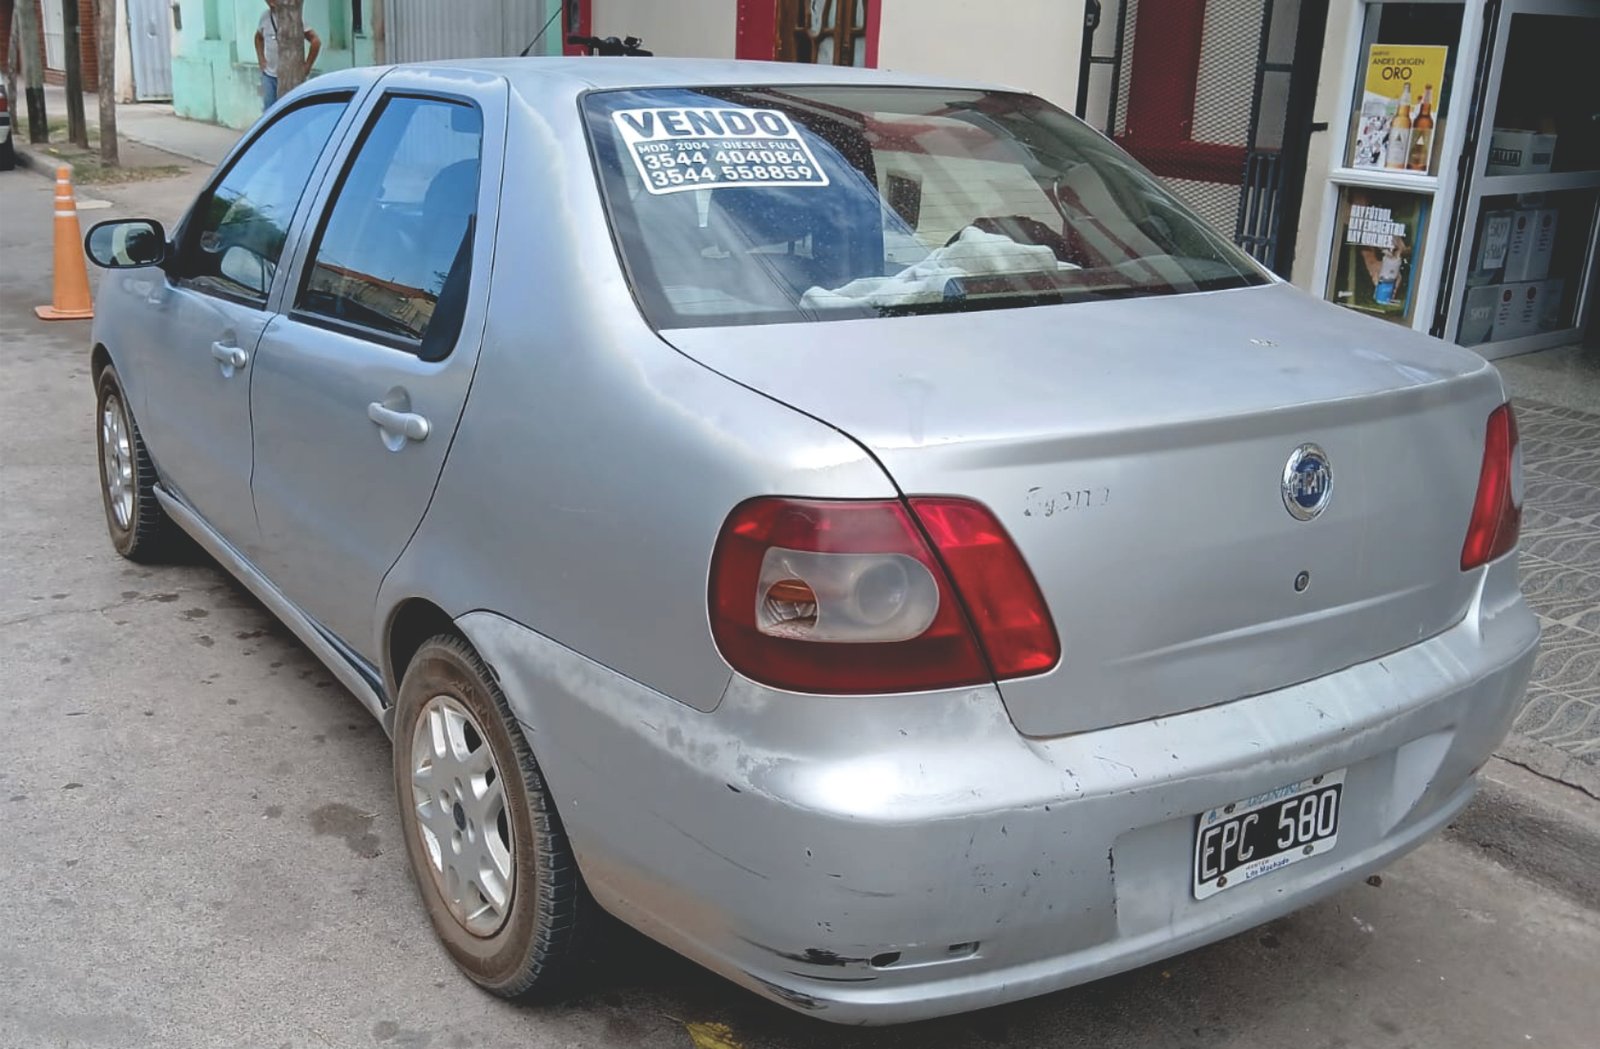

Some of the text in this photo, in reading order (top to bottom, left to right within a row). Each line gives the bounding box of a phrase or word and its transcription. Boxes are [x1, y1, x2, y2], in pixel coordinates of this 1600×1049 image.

[1372, 57, 1425, 66] ANDES ORIGEN
[1381, 66, 1413, 81] ORO
[620, 110, 790, 138] VENDO
[638, 143, 674, 154] MOD.
[675, 142, 710, 151] 2004
[721, 141, 767, 151] DIESEL
[768, 141, 801, 151] FULL
[644, 150, 807, 170] 3544 404084
[652, 165, 813, 187] 3544 558859
[1202, 789, 1338, 881] EPC 580
